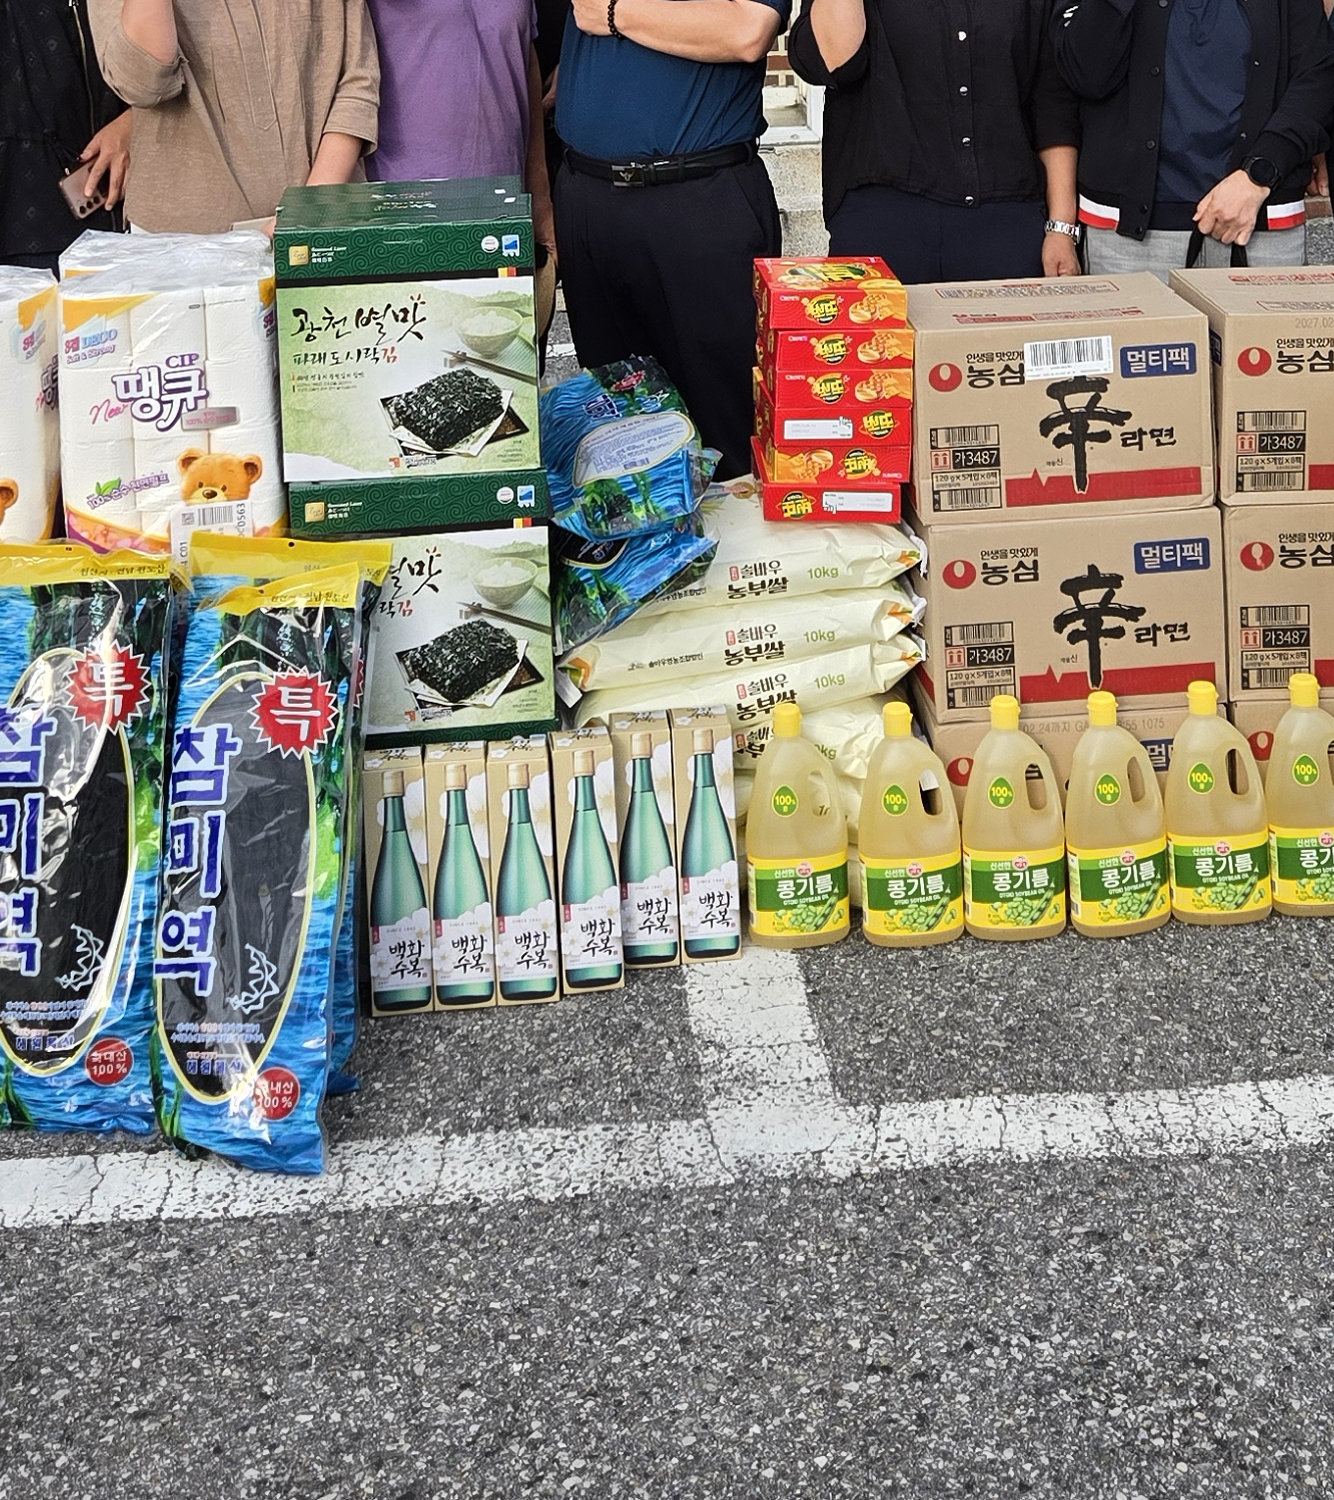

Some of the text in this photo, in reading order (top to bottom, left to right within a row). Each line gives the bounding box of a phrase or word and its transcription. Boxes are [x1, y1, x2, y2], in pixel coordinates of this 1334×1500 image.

[1276, 337, 1334, 349] 인생을 맛있게
[166, 353, 199, 368] CIP
[967, 350, 1024, 364] 인생을 맛있게
[1126, 347, 1189, 373] 멀티팩
[1276, 350, 1334, 374] 농심
[967, 364, 1025, 389] 농심
[112, 366, 209, 431] 땡큐
[1039, 376, 1132, 493] 辛
[1120, 427, 1177, 451] 라면
[1260, 435, 1303, 450] 가3487
[954, 451, 998, 467] 가3487
[1278, 533, 1306, 543] 인생을
[180, 541, 188, 557] C01
[981, 547, 1038, 560] 인생을 맛있게
[1140, 544, 1204, 569] 멀티팩
[739, 560, 783, 579] 솔바우
[807, 566, 839, 581] 10kg
[981, 560, 1039, 586] 농심
[727, 577, 789, 600] 농부쌀
[736, 623, 778, 642] 솔바우
[1054, 564, 1146, 688] 辛
[1134, 622, 1190, 647] 라면
[803, 629, 836, 644] 10kg
[1265, 631, 1308, 646] 가3487
[724, 641, 786, 666] 농부쌀
[969, 647, 1012, 664] 가3487
[83, 660, 133, 717] 특
[747, 673, 790, 697] 솔바우
[813, 673, 845, 689] 10kg
[270, 687, 321, 741] 특
[1142, 718, 1165, 730] 1075
[154, 726, 242, 995] 참미역
[1196, 854, 1253, 876] 콩기름
[774, 868, 794, 877] 신선한
[884, 868, 905, 877] 신선한
[993, 869, 1049, 892] 콩기름
[1101, 861, 1155, 889] 콩기름
[777, 874, 833, 898] 콩기름
[887, 875, 944, 898] 콩기름
[636, 898, 672, 915] 백화
[699, 892, 733, 908] 백화
[581, 919, 616, 936] 백화
[638, 915, 670, 935] 수복
[705, 910, 732, 928] 수복
[389, 941, 425, 959] 백화
[451, 936, 487, 953] 백화
[515, 932, 550, 950] 백화
[583, 937, 613, 956] 수복
[391, 959, 422, 979] 수복
[454, 953, 485, 974] 수복
[516, 950, 549, 971] 수복
